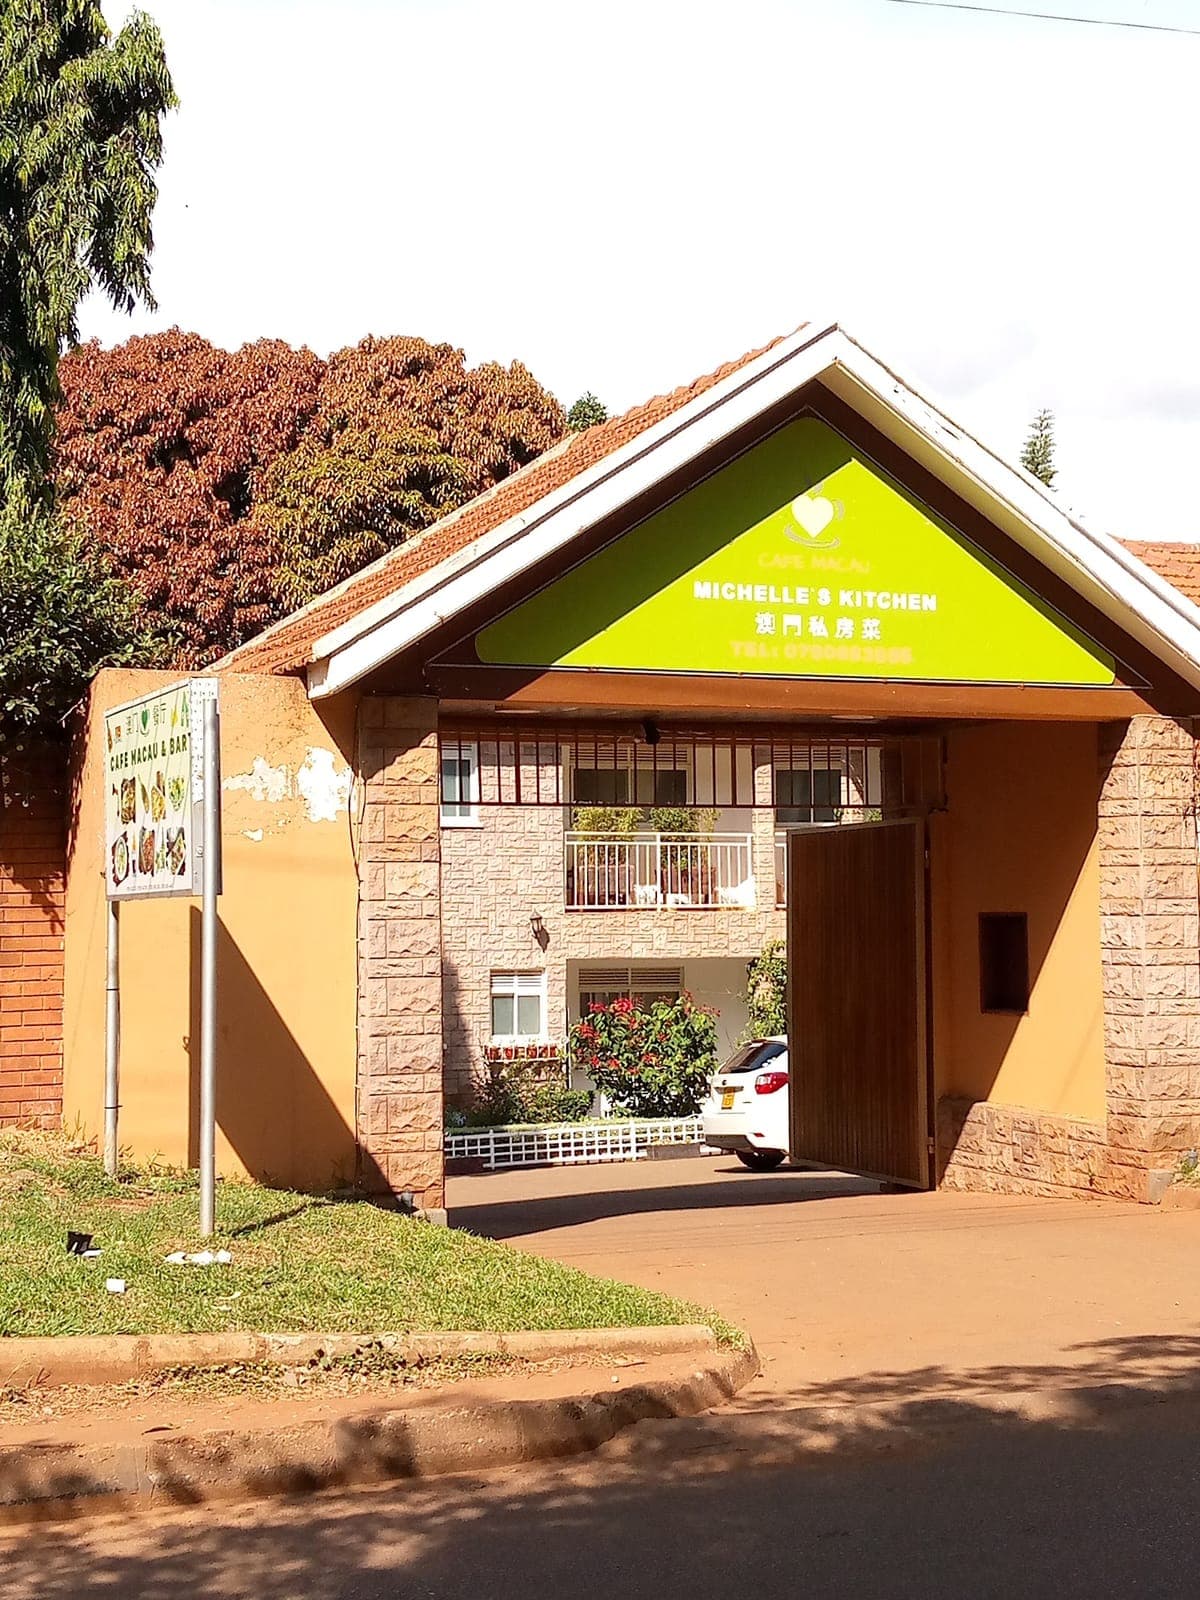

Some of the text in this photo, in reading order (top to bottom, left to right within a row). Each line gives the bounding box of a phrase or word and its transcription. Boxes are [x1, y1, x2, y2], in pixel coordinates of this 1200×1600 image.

[757, 552, 804, 570] CAFE
[839, 590, 937, 611] KITCHEN
[755, 611, 881, 640] 澳門私房菜
[110, 735, 188, 772] CAFE MACAU & BAR
